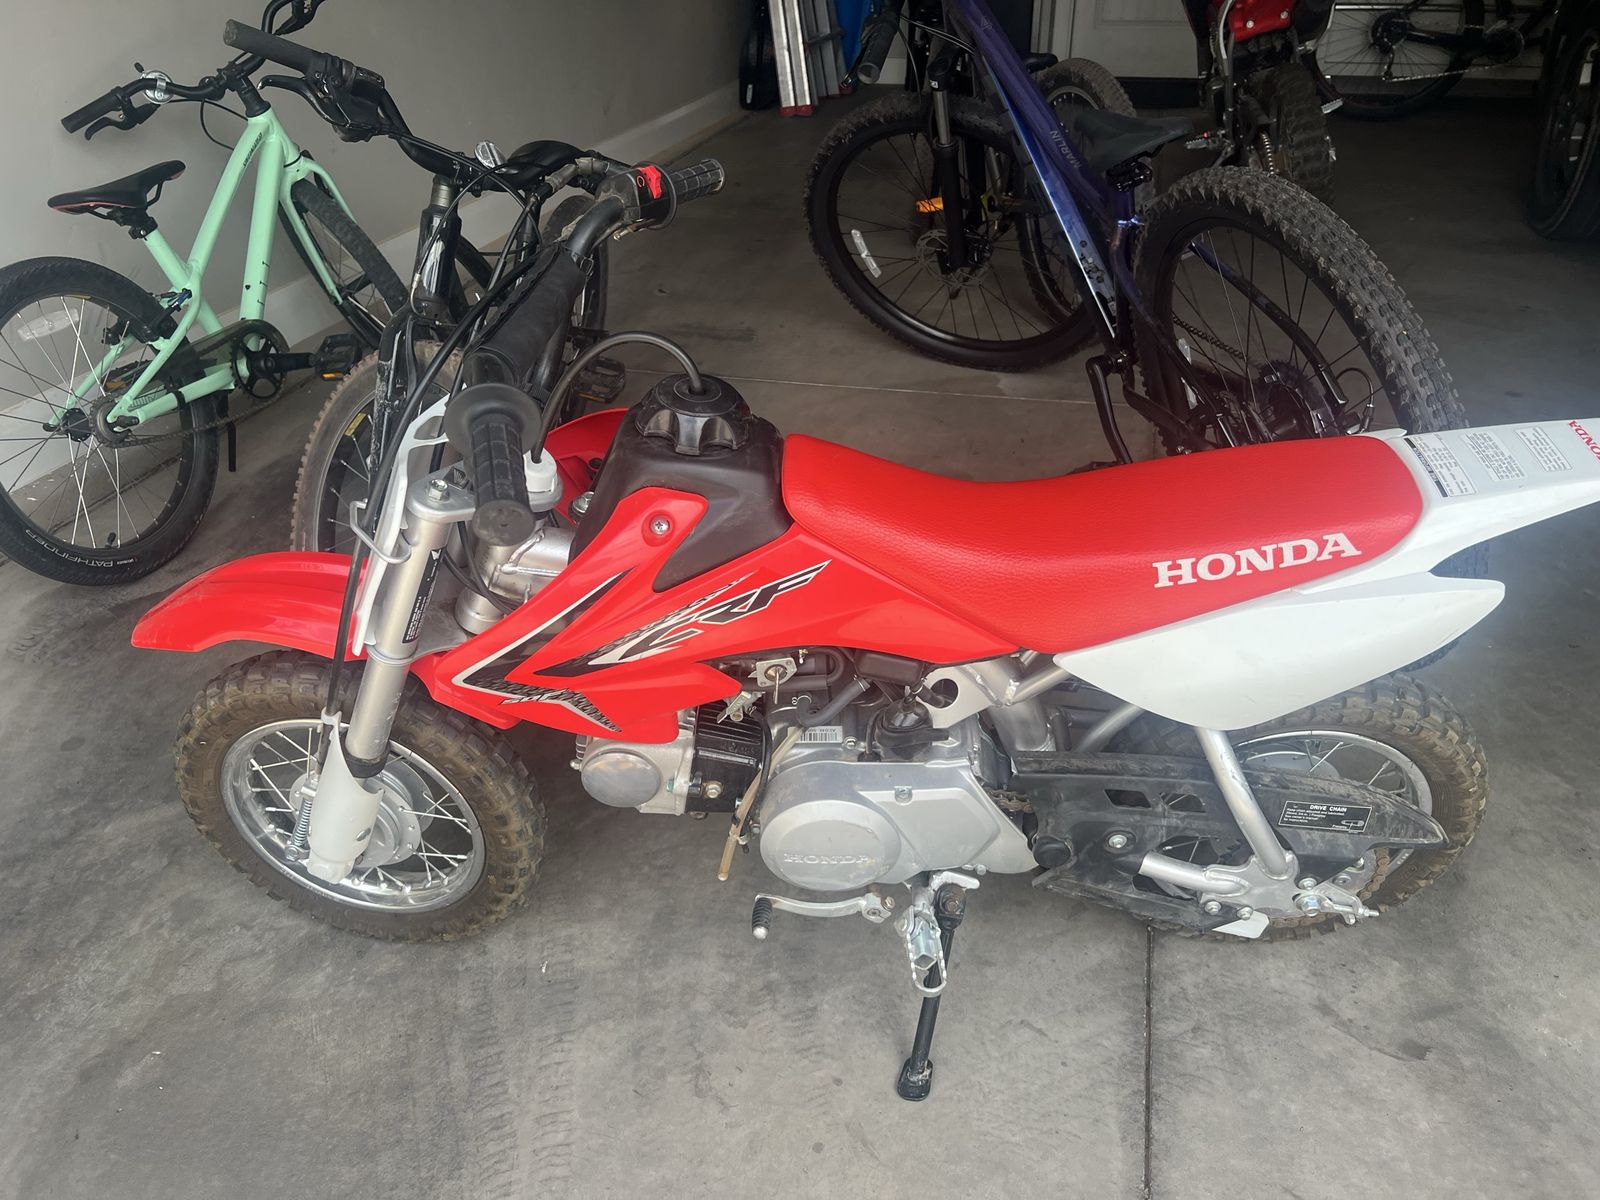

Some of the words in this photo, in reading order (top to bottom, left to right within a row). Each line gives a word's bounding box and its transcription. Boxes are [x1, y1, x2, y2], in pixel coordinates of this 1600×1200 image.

[1050, 130, 1083, 168] MARLIN
[1568, 420, 1600, 460] ONDA
[25, 529, 114, 568] PATHFINDER
[1152, 532, 1362, 588] HONDA
[588, 559, 832, 665] CRF
[783, 852, 872, 864] HONDA
